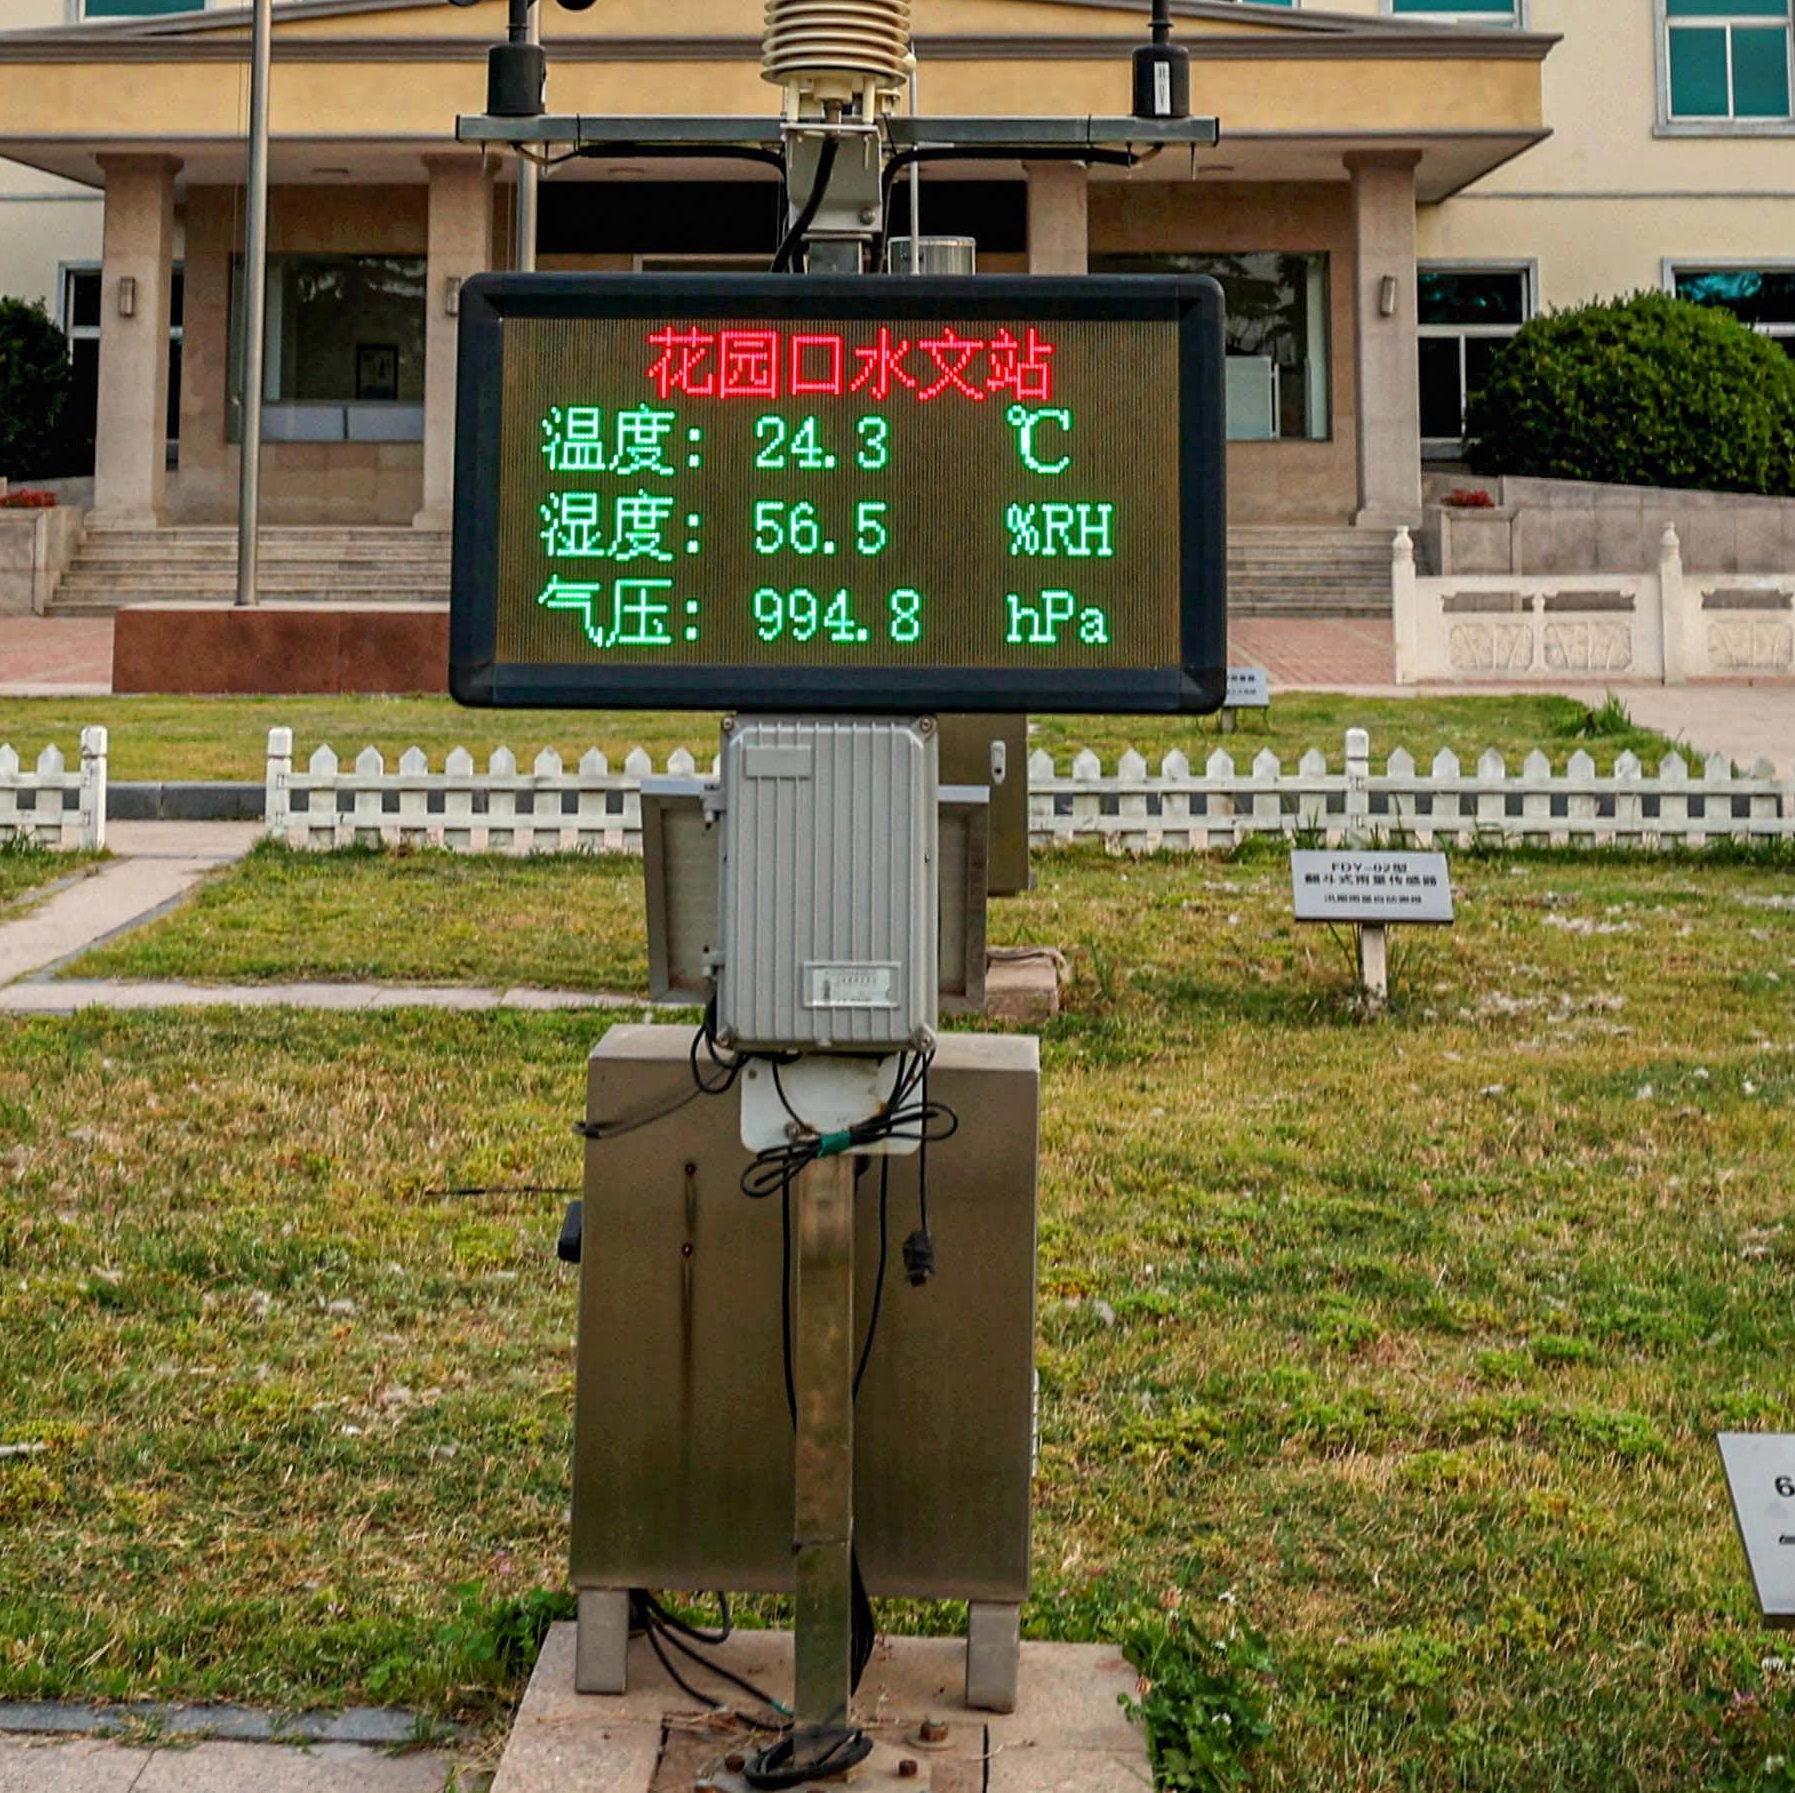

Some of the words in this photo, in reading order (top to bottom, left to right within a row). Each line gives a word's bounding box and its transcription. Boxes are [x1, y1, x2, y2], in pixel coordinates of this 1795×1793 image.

[647, 325, 1053, 401] 花园口水文站
[755, 415, 890, 470] 24.3
[755, 502, 888, 555] 56.5
[1007, 503, 1113, 557] %RH
[755, 588, 923, 642] 994.8
[1007, 591, 1108, 644] hPa
